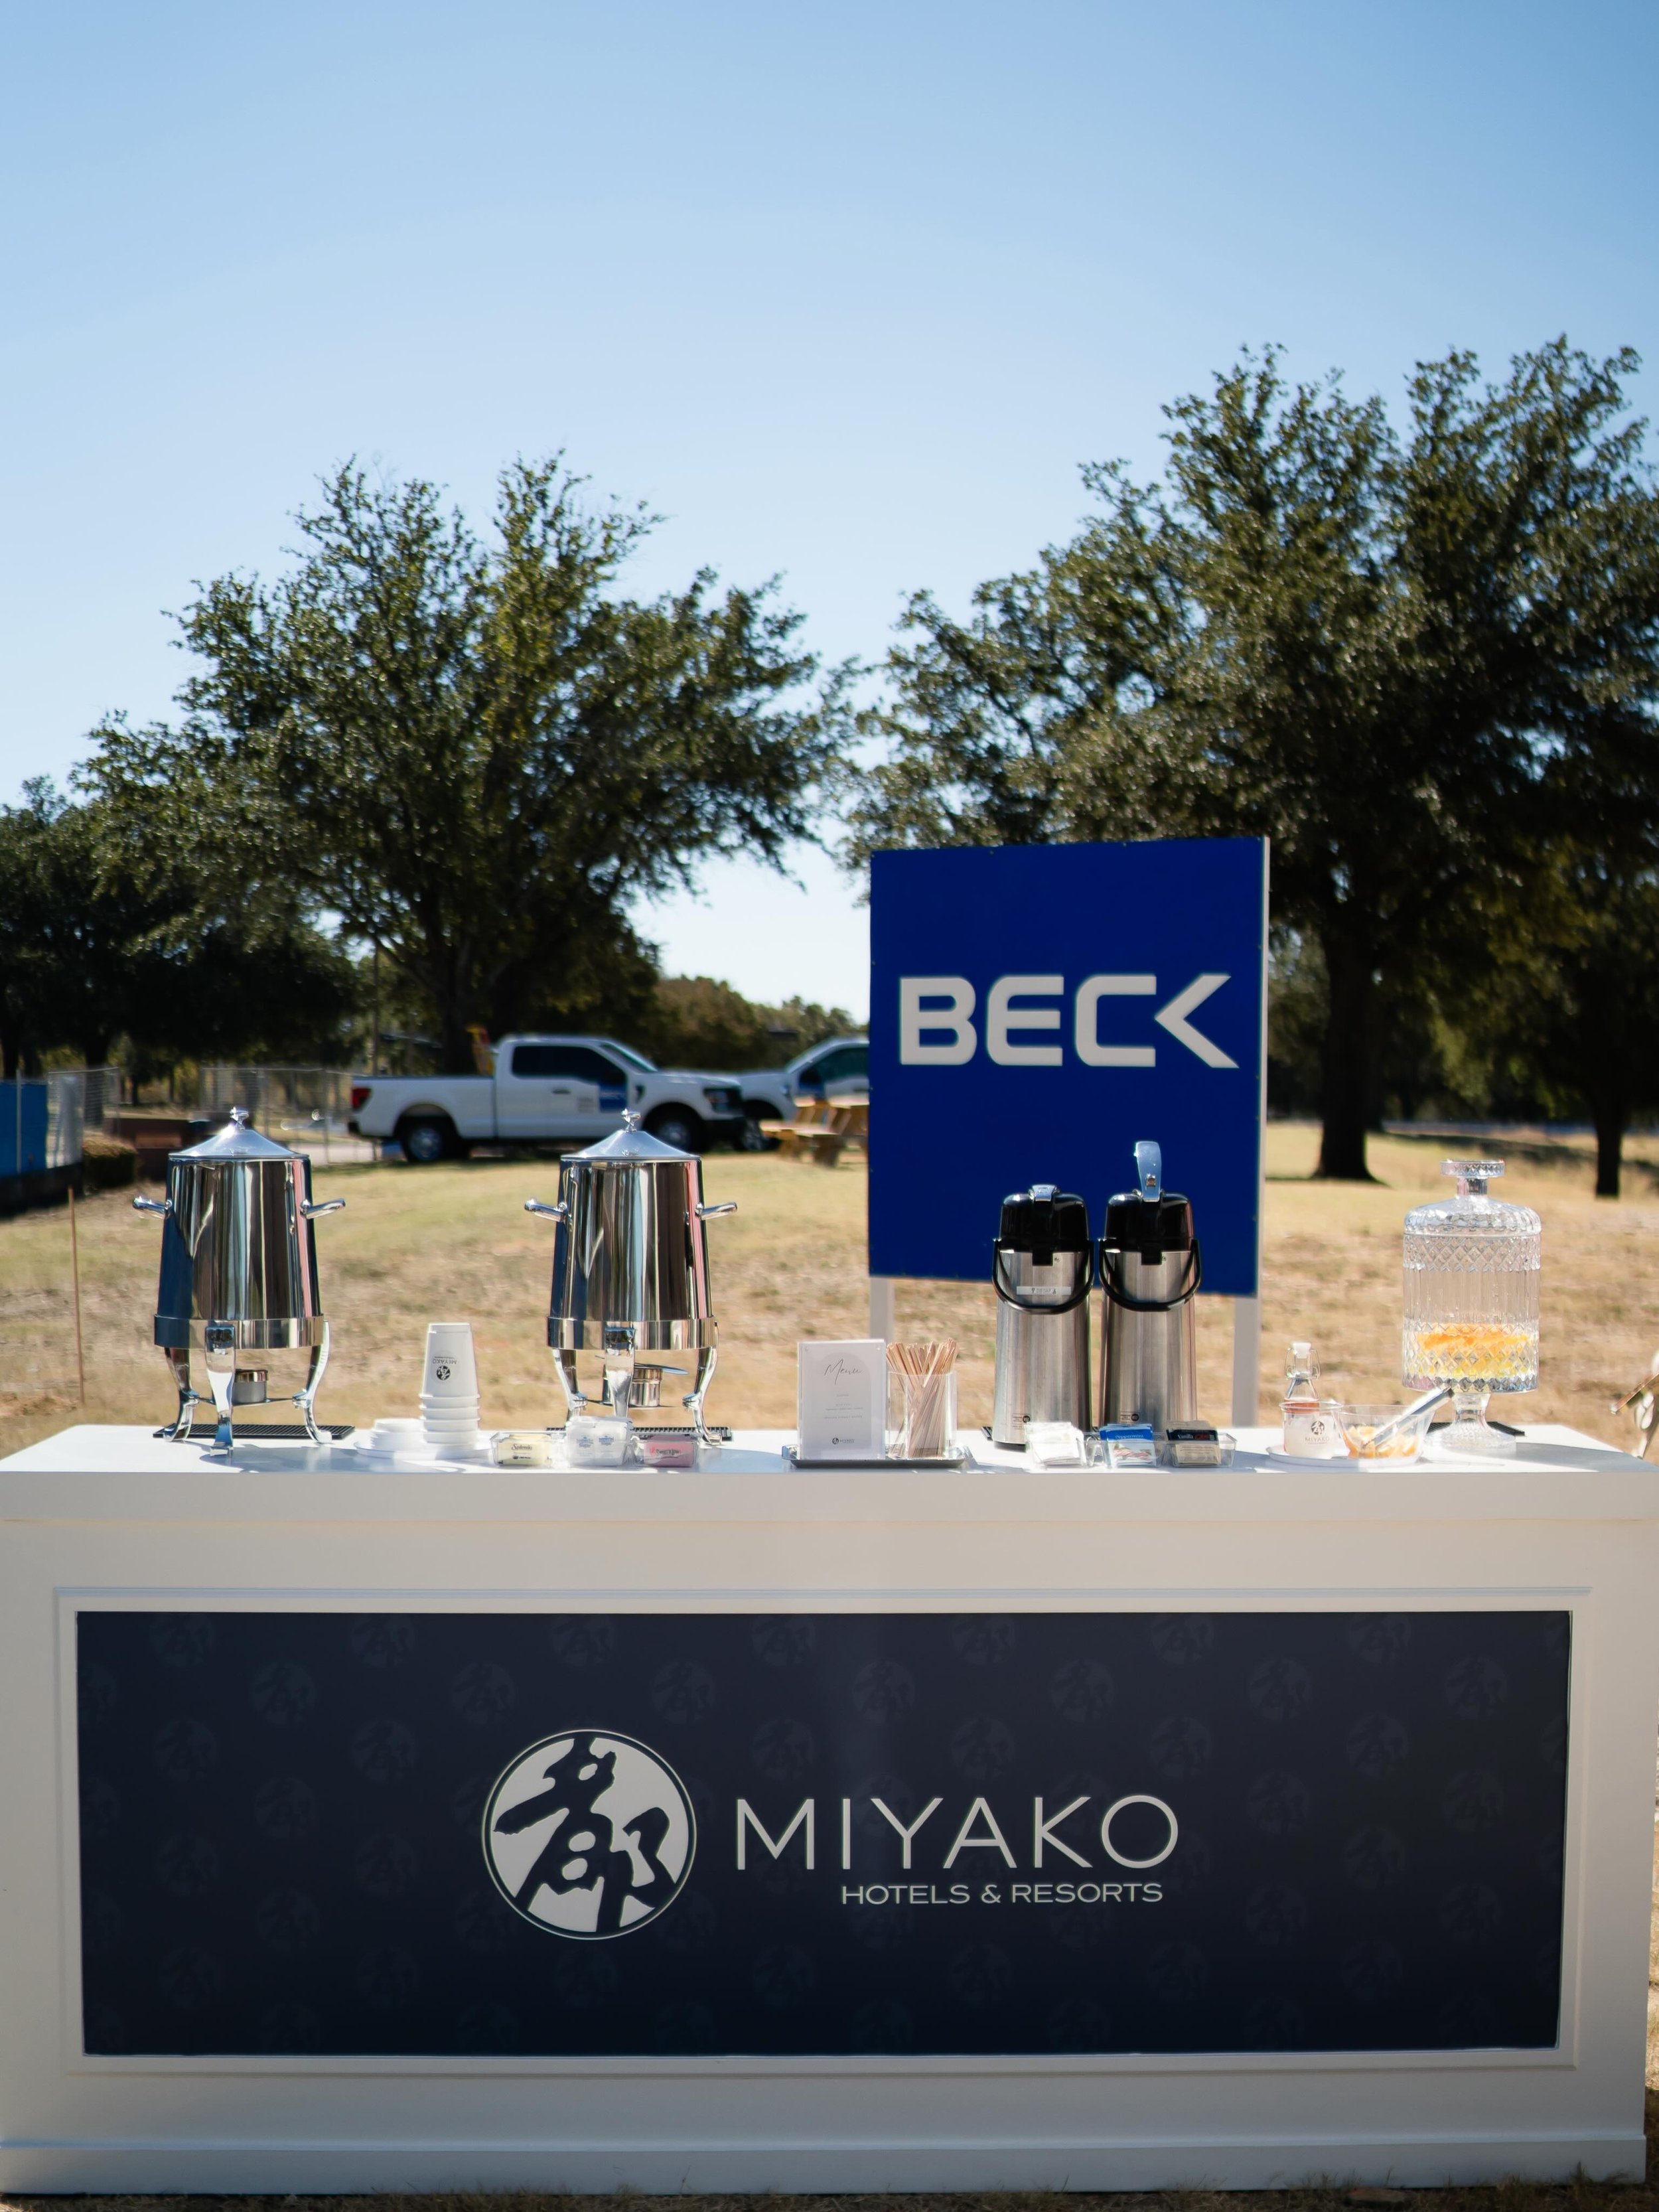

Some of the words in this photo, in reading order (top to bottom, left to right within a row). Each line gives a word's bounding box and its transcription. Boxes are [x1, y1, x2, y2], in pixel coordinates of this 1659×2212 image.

[900, 974, 1240, 1069] BECK
[824, 1359, 862, 1385] Menu
[737, 1795, 1179, 1870] MIYAKO
[841, 1883, 970, 1905] HOTELS
[981, 1884, 1002, 1904] &
[1012, 1883, 1163, 1903] RESORTS
